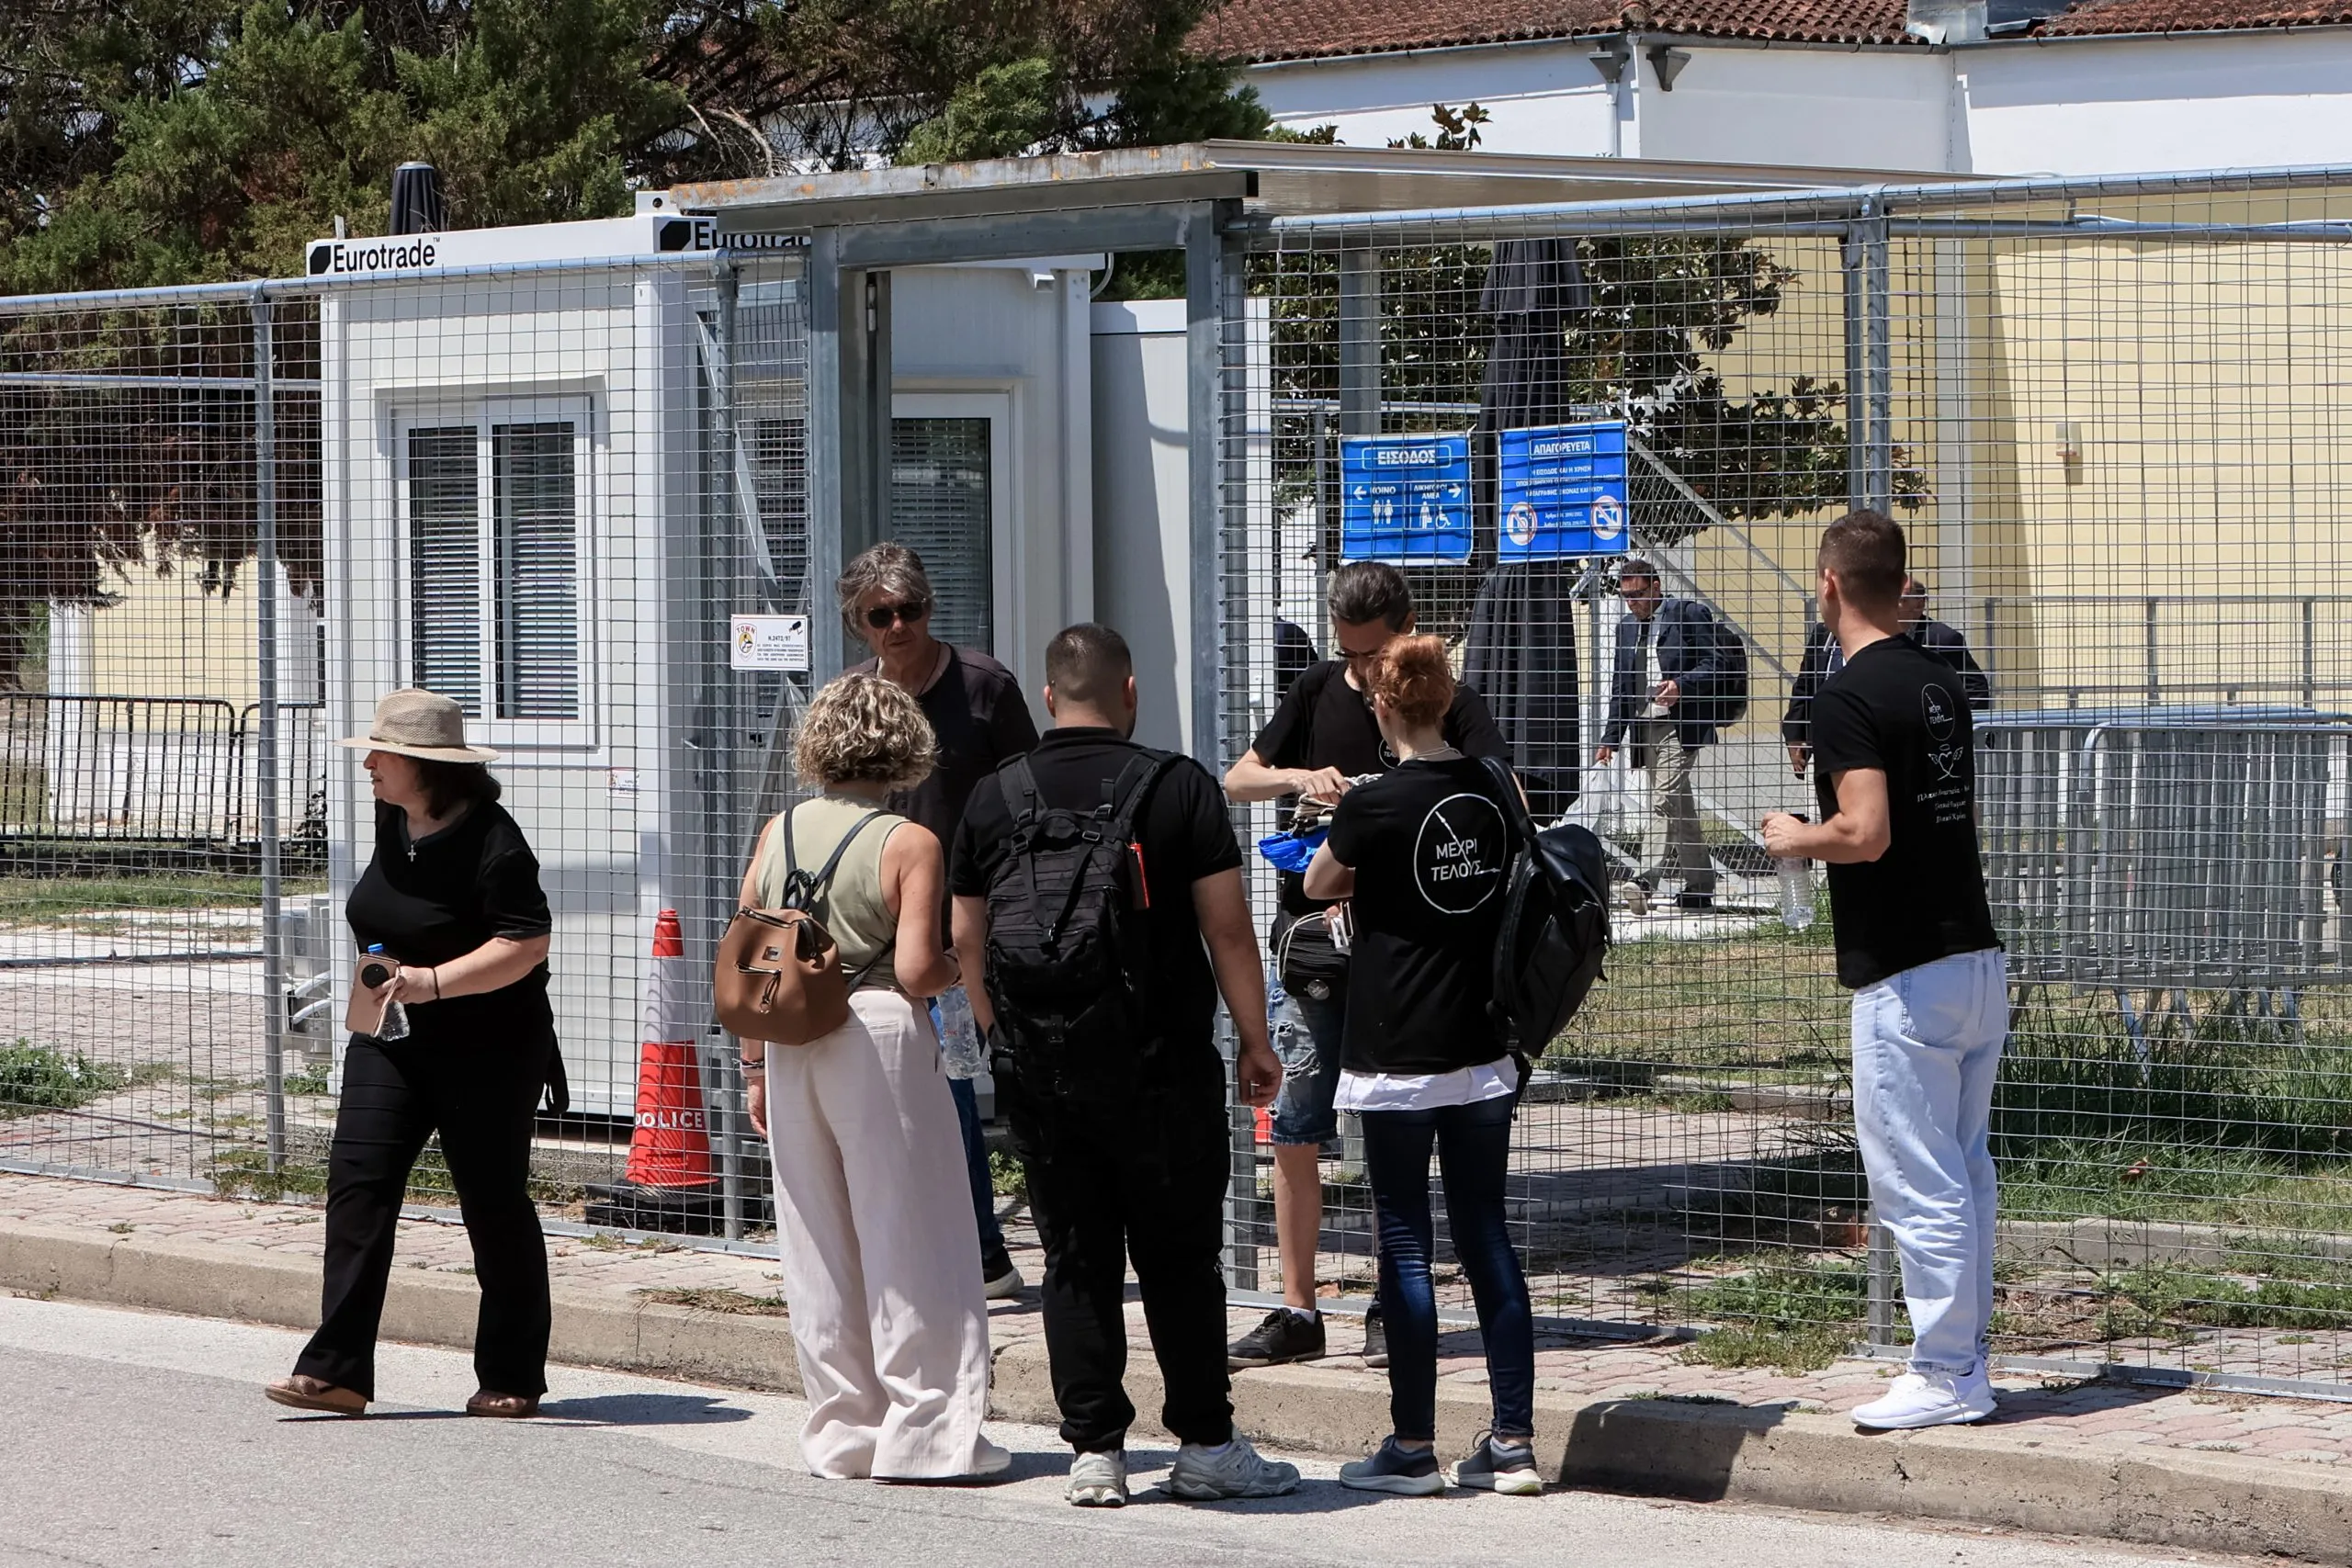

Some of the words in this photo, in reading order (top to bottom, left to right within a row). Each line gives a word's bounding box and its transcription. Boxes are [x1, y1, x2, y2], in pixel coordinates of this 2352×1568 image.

[334, 238, 435, 272] Eurotrade
[1377, 449, 1436, 466] ΕΙΣΟΔΟΣ
[1435, 838, 1477, 860] ΜΕΧΡΙ
[1430, 860, 1482, 882] ΤΕΛΟΥΣ
[635, 1111, 703, 1129] POLICE
